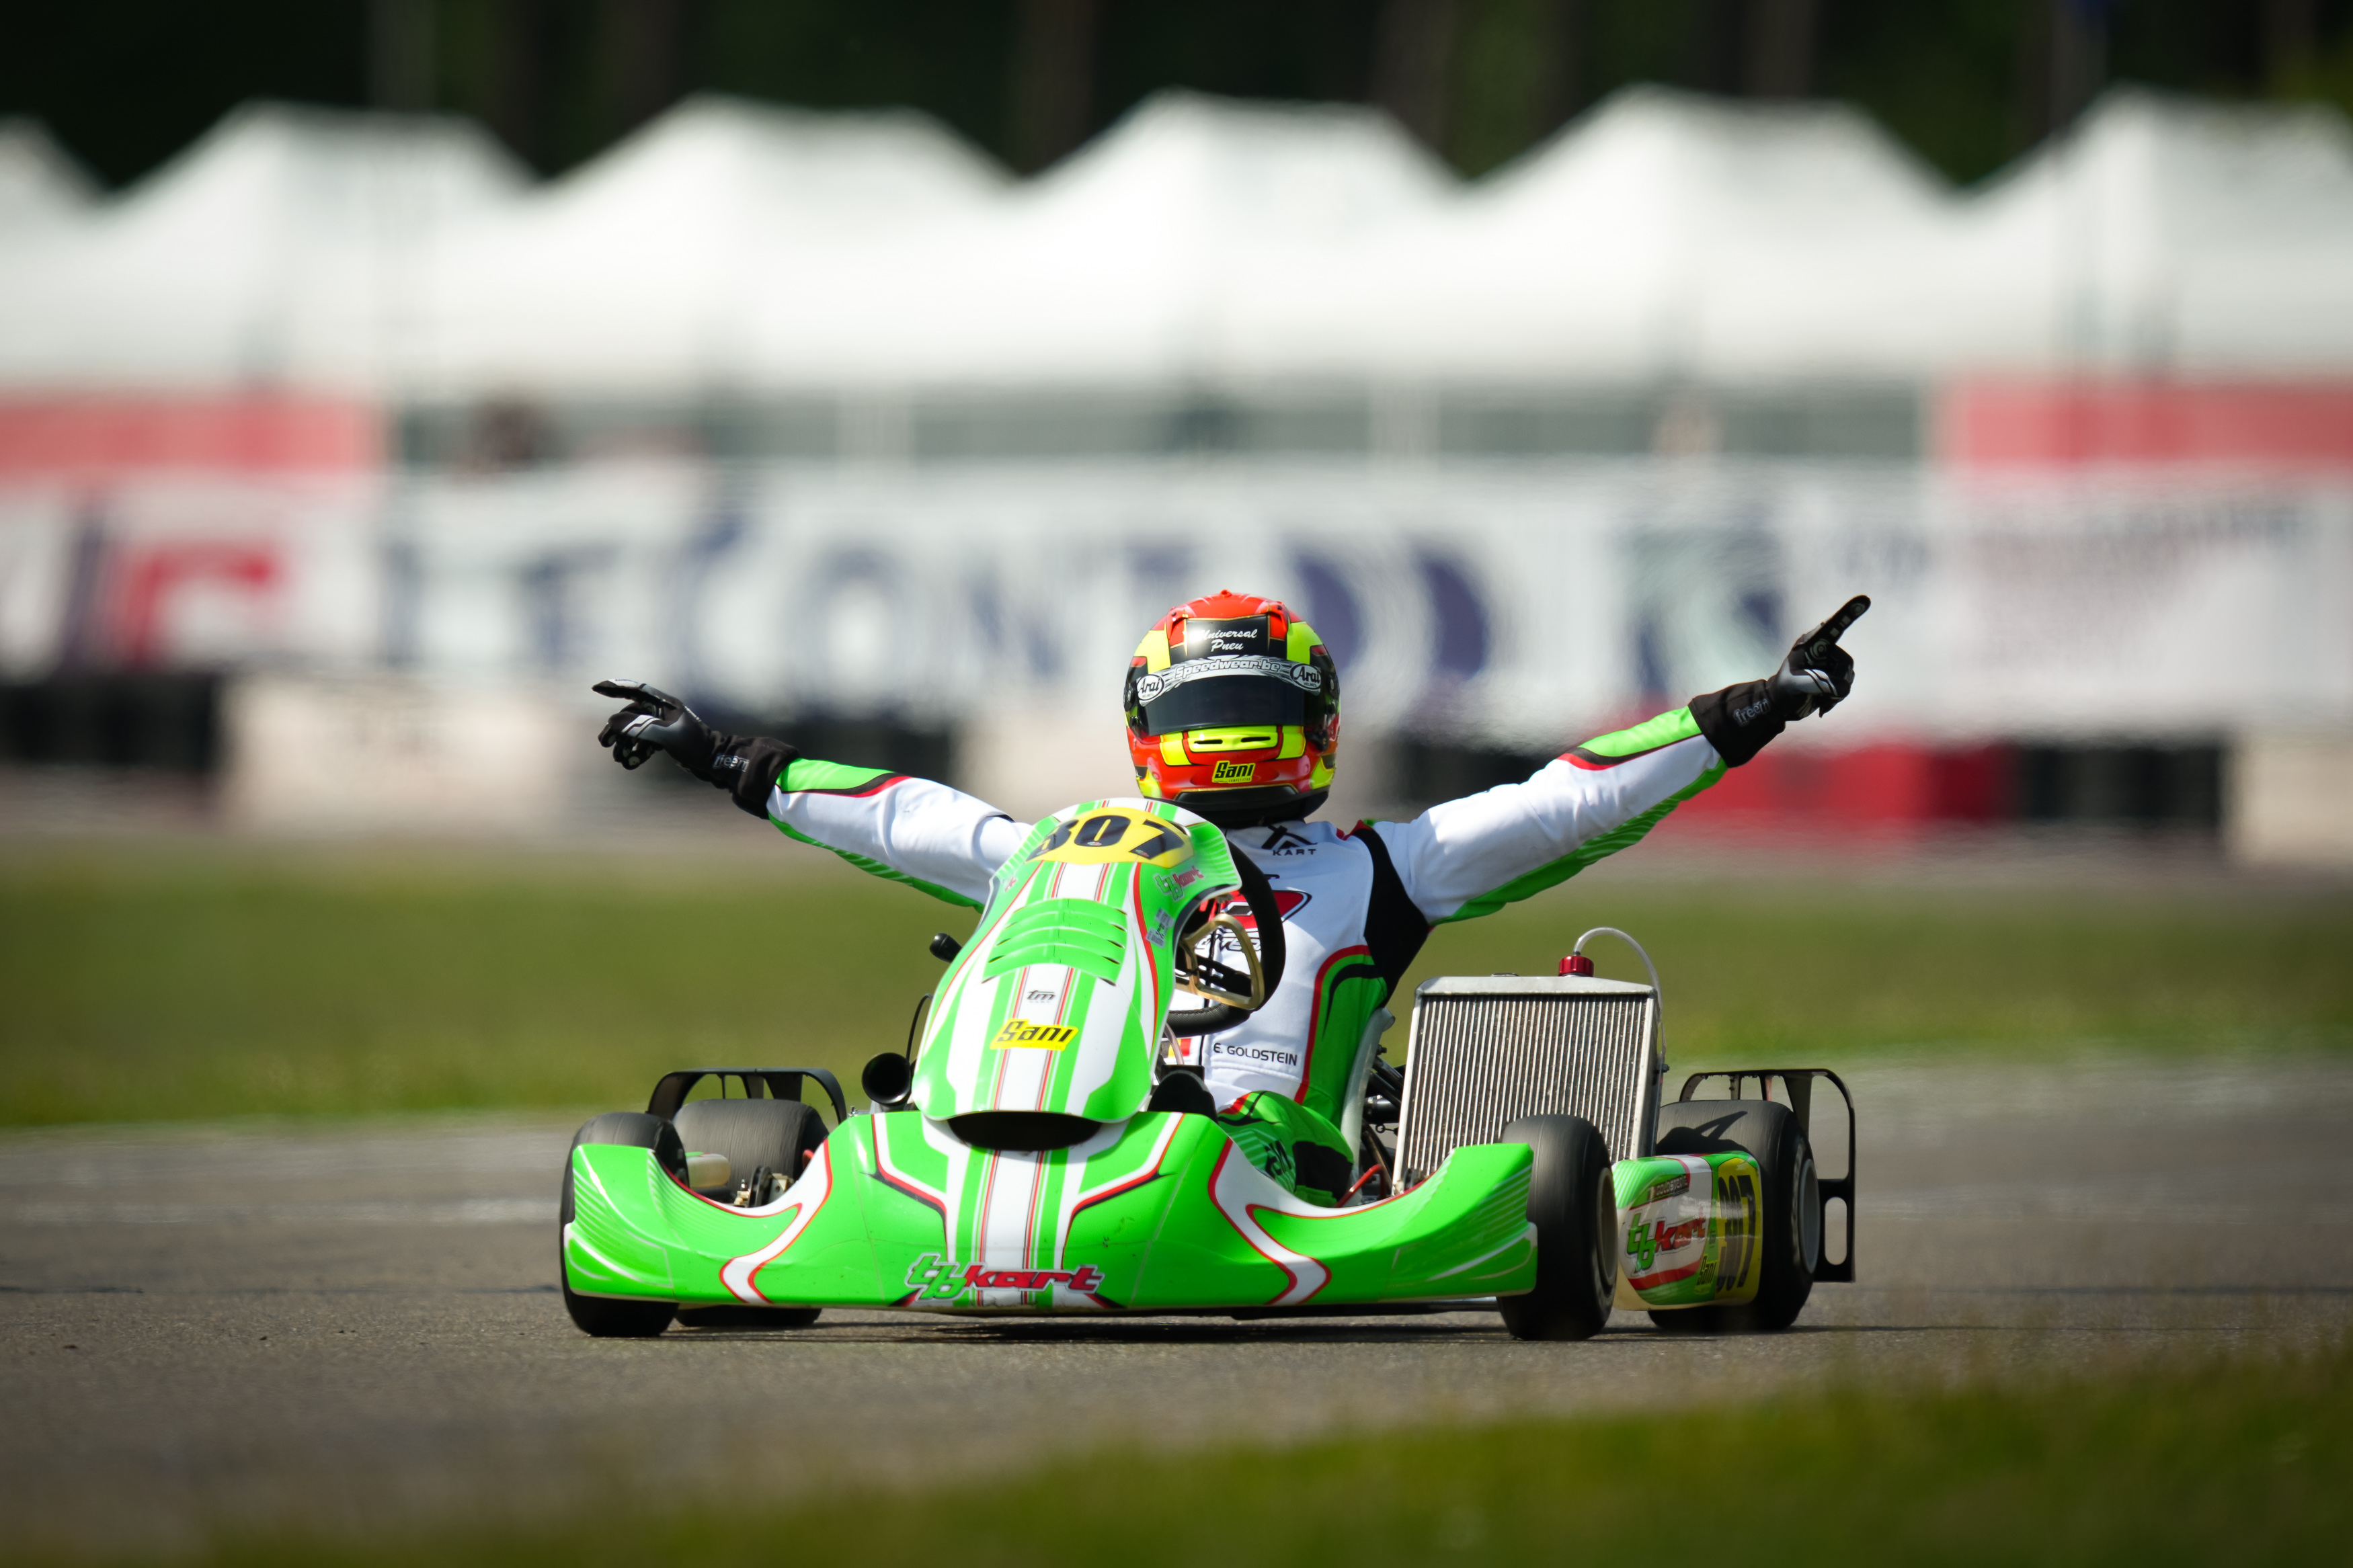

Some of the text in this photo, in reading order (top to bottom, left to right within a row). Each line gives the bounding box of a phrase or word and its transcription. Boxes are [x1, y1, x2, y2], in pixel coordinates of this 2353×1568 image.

[1211, 638, 1244, 652] Pneu
[1174, 659, 1281, 679] Speedwear.be
[1293, 665, 1320, 684] Arai
[1140, 677, 1160, 694] Arai
[1213, 1042, 1298, 1066] E. GOLDSTEIN
